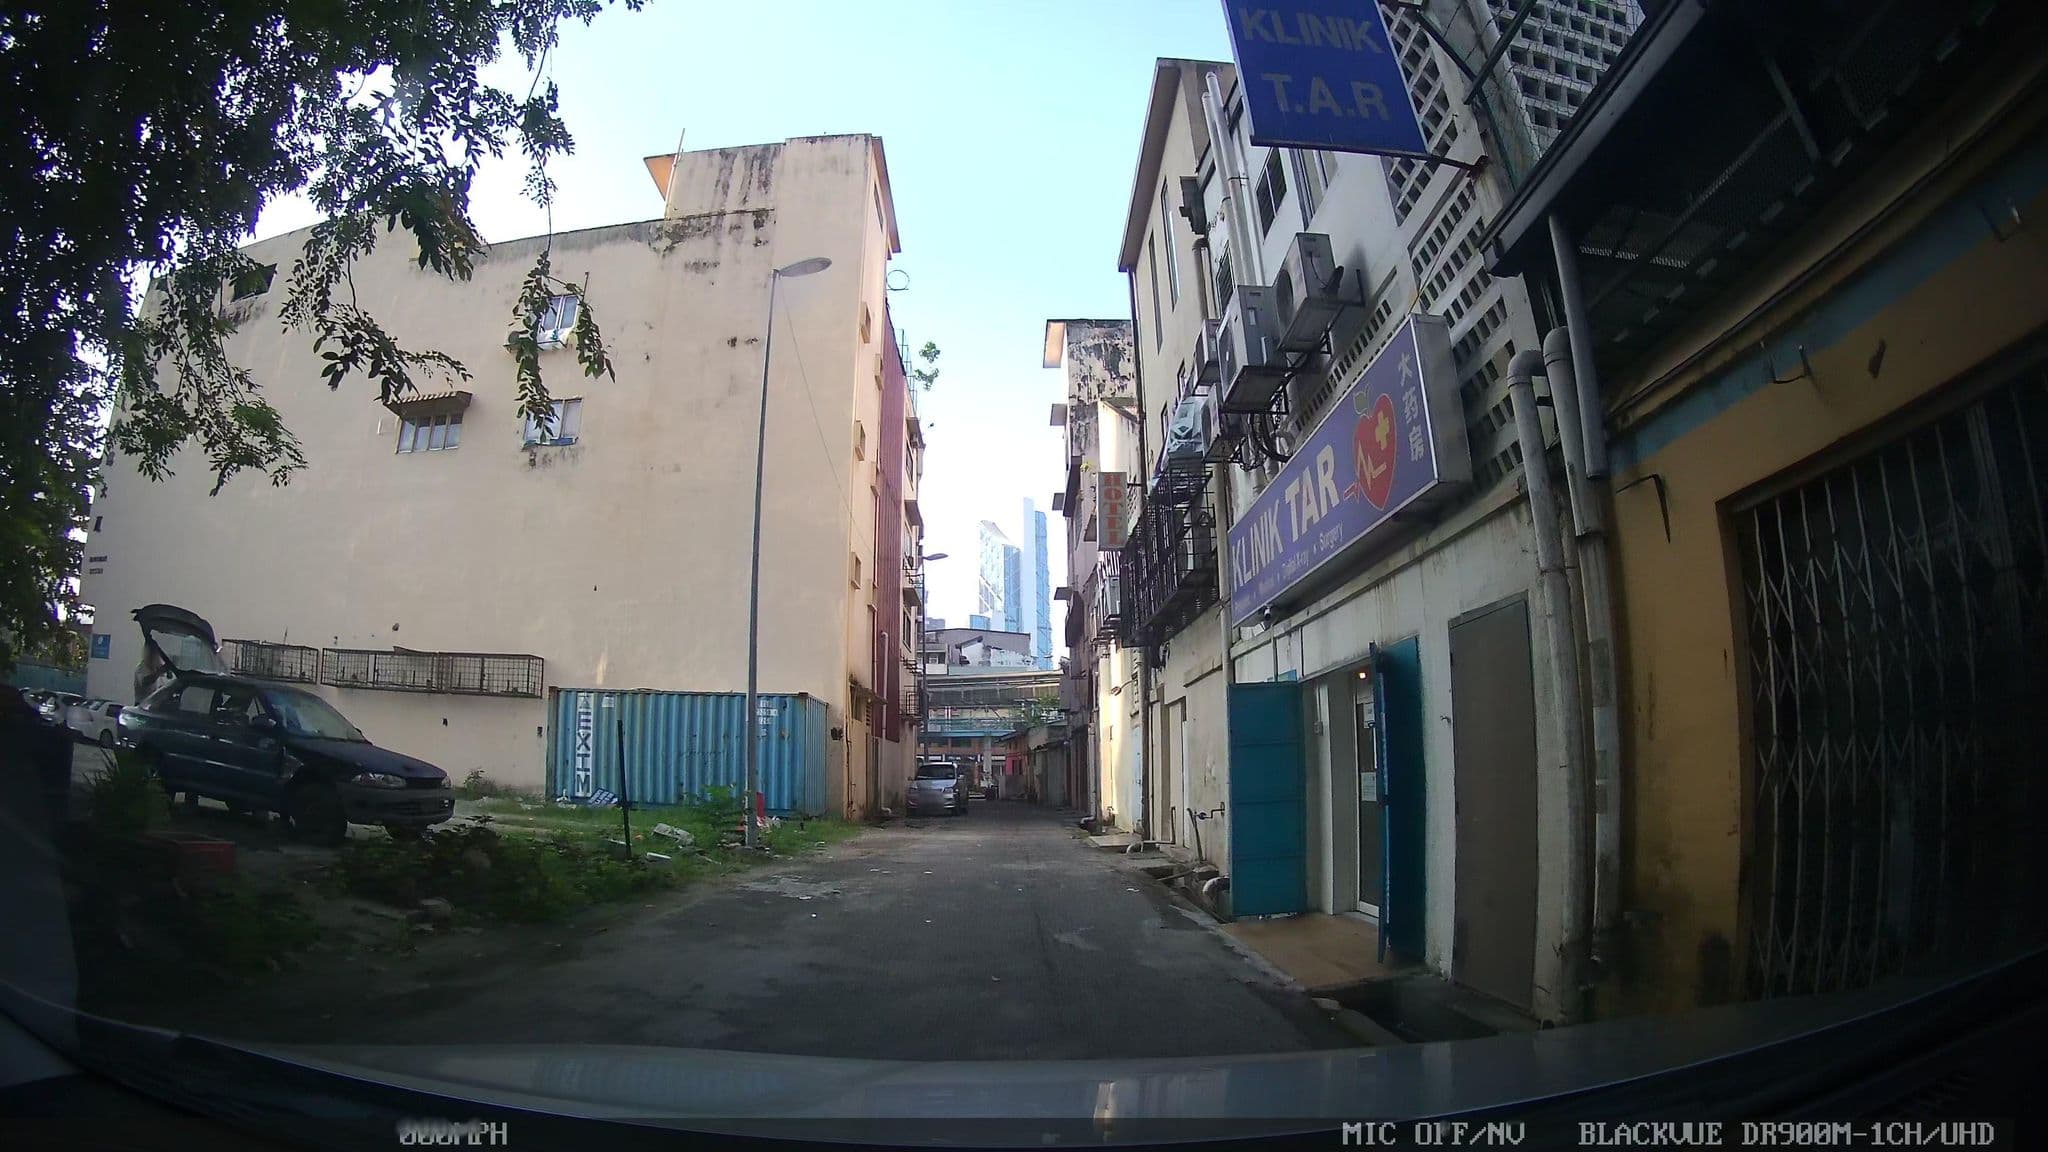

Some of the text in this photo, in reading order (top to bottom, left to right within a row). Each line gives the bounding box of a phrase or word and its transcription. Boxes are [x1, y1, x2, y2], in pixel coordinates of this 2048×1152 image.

[1239, 8, 1384, 53] KLINIK
[1261, 72, 1390, 120] T.A.R
[1103, 474, 1124, 545] HOTEL
[1231, 444, 1340, 593] KLINIK TAR
